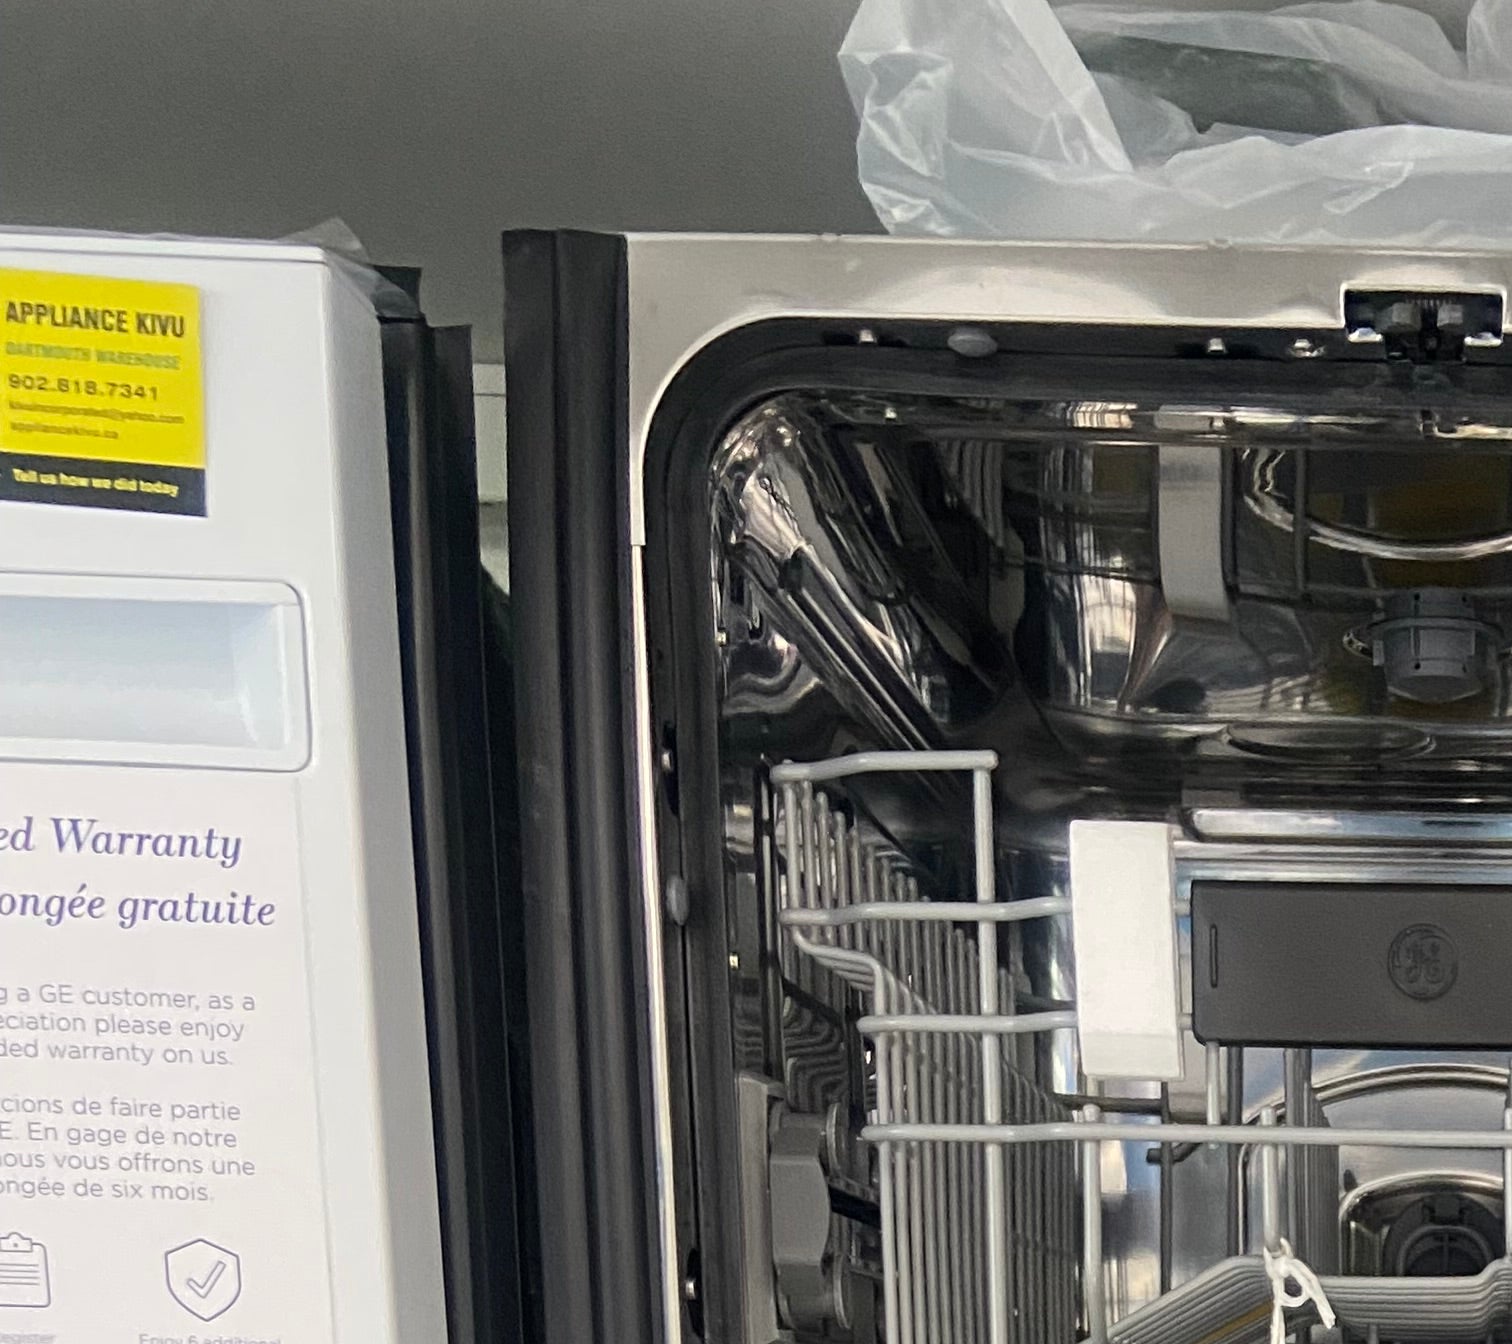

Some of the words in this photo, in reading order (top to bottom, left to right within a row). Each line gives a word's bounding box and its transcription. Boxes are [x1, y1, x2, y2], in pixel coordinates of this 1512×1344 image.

[6, 301, 129, 333] APPLIANCE
[136, 312, 185, 337] KIVU
[139, 480, 179, 498] today
[50, 817, 243, 868] Warranty
[0, 883, 105, 927] ongée
[118, 892, 276, 929] gratuite
[17, 987, 30, 1003] a
[39, 984, 74, 1004] GE
[82, 987, 201, 1011] customer,
[208, 994, 234, 1011] as
[242, 995, 256, 1011] a
[95, 1013, 172, 1038] please
[180, 1016, 244, 1042] enjoy
[47, 1042, 153, 1066] warranty
[162, 1047, 193, 1065] on
[201, 1048, 233, 1066] us.
[72, 1096, 102, 1115] de
[110, 1096, 162, 1117] faire
[171, 1100, 241, 1121] partie
[27, 1121, 58, 1141] En
[67, 1127, 127, 1147] gage
[136, 1125, 165, 1146] de
[173, 1128, 237, 1148] notre
[53, 1153, 110, 1171] vous
[118, 1152, 204, 1175] offrons
[212, 1157, 256, 1176] une
[74, 1178, 103, 1198] de
[111, 1179, 143, 1198] six
[152, 1179, 214, 1202] mois.
